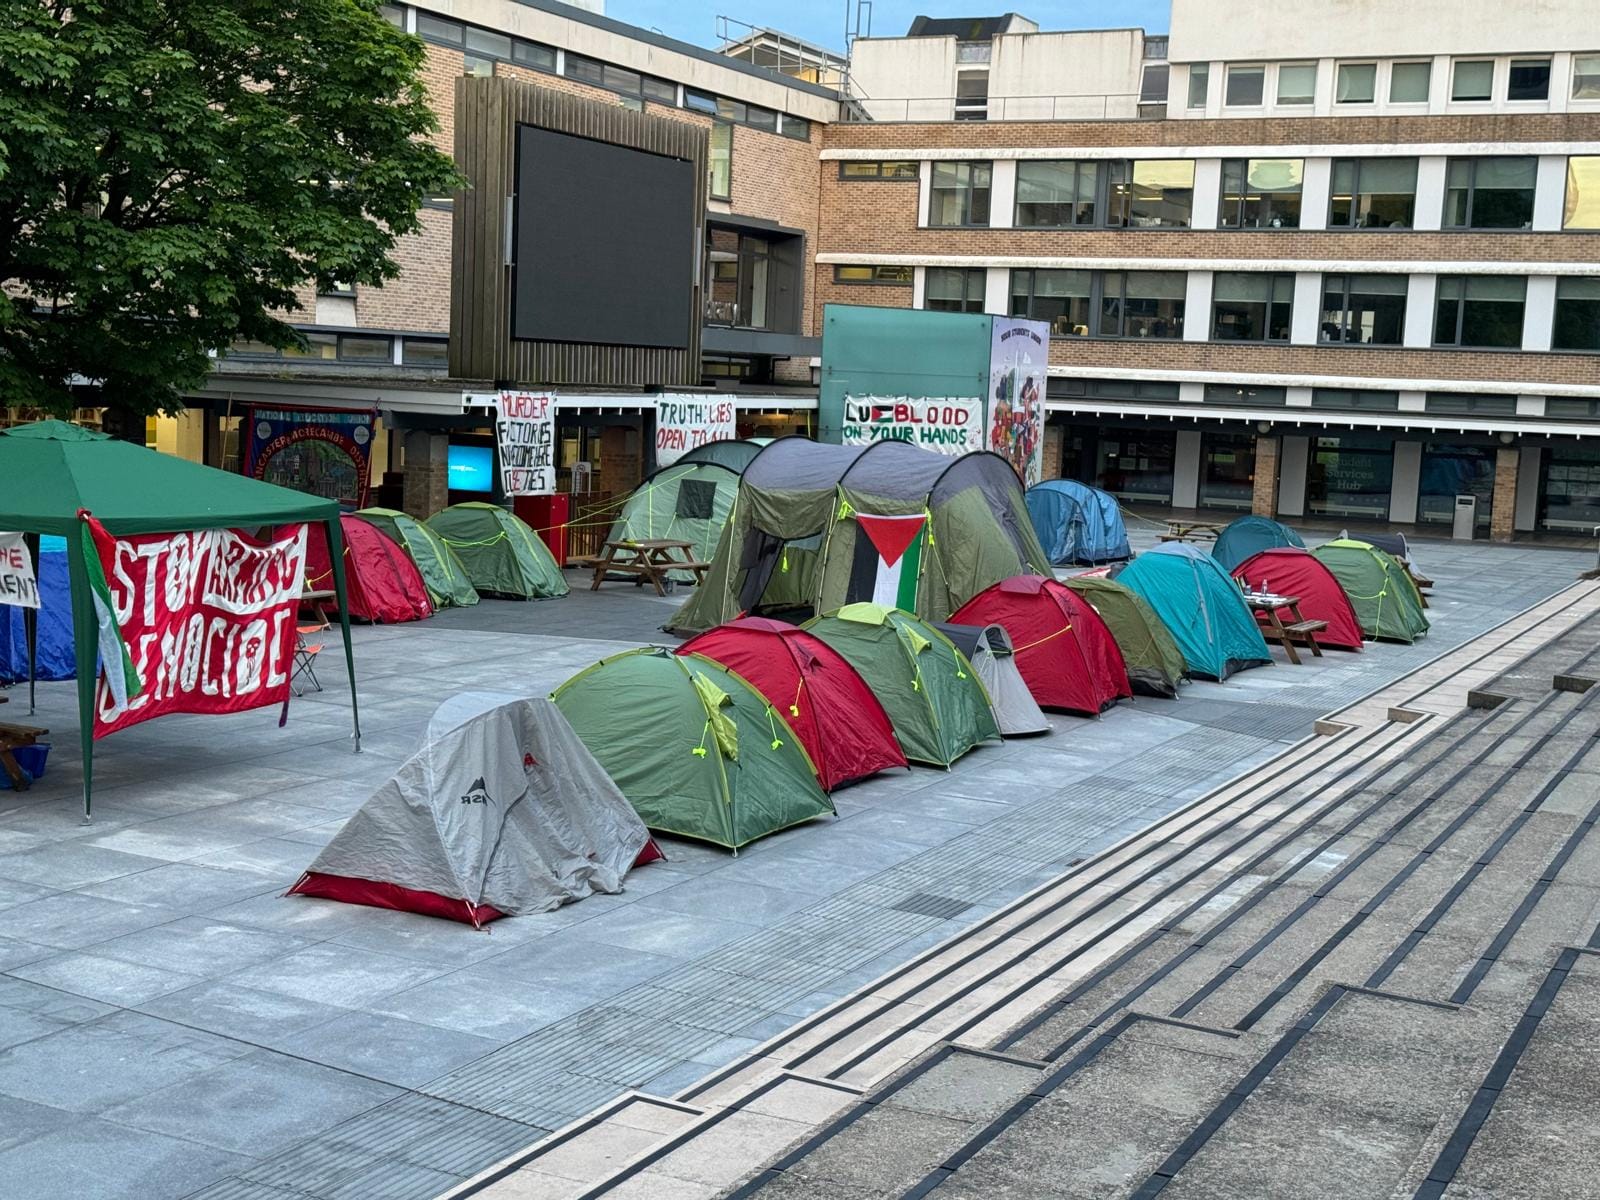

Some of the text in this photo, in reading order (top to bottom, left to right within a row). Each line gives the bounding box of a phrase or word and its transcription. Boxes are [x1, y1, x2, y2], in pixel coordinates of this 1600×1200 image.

[501, 394, 549, 419] MURDER
[845, 403, 969, 425] LU BLOOD
[656, 428, 687, 450] OPEN
[691, 429, 707, 448] TO
[843, 425, 967, 445] ON YOUR HANDS
[255, 435, 288, 481] NCASTER
[1337, 479, 1362, 490] Hub
